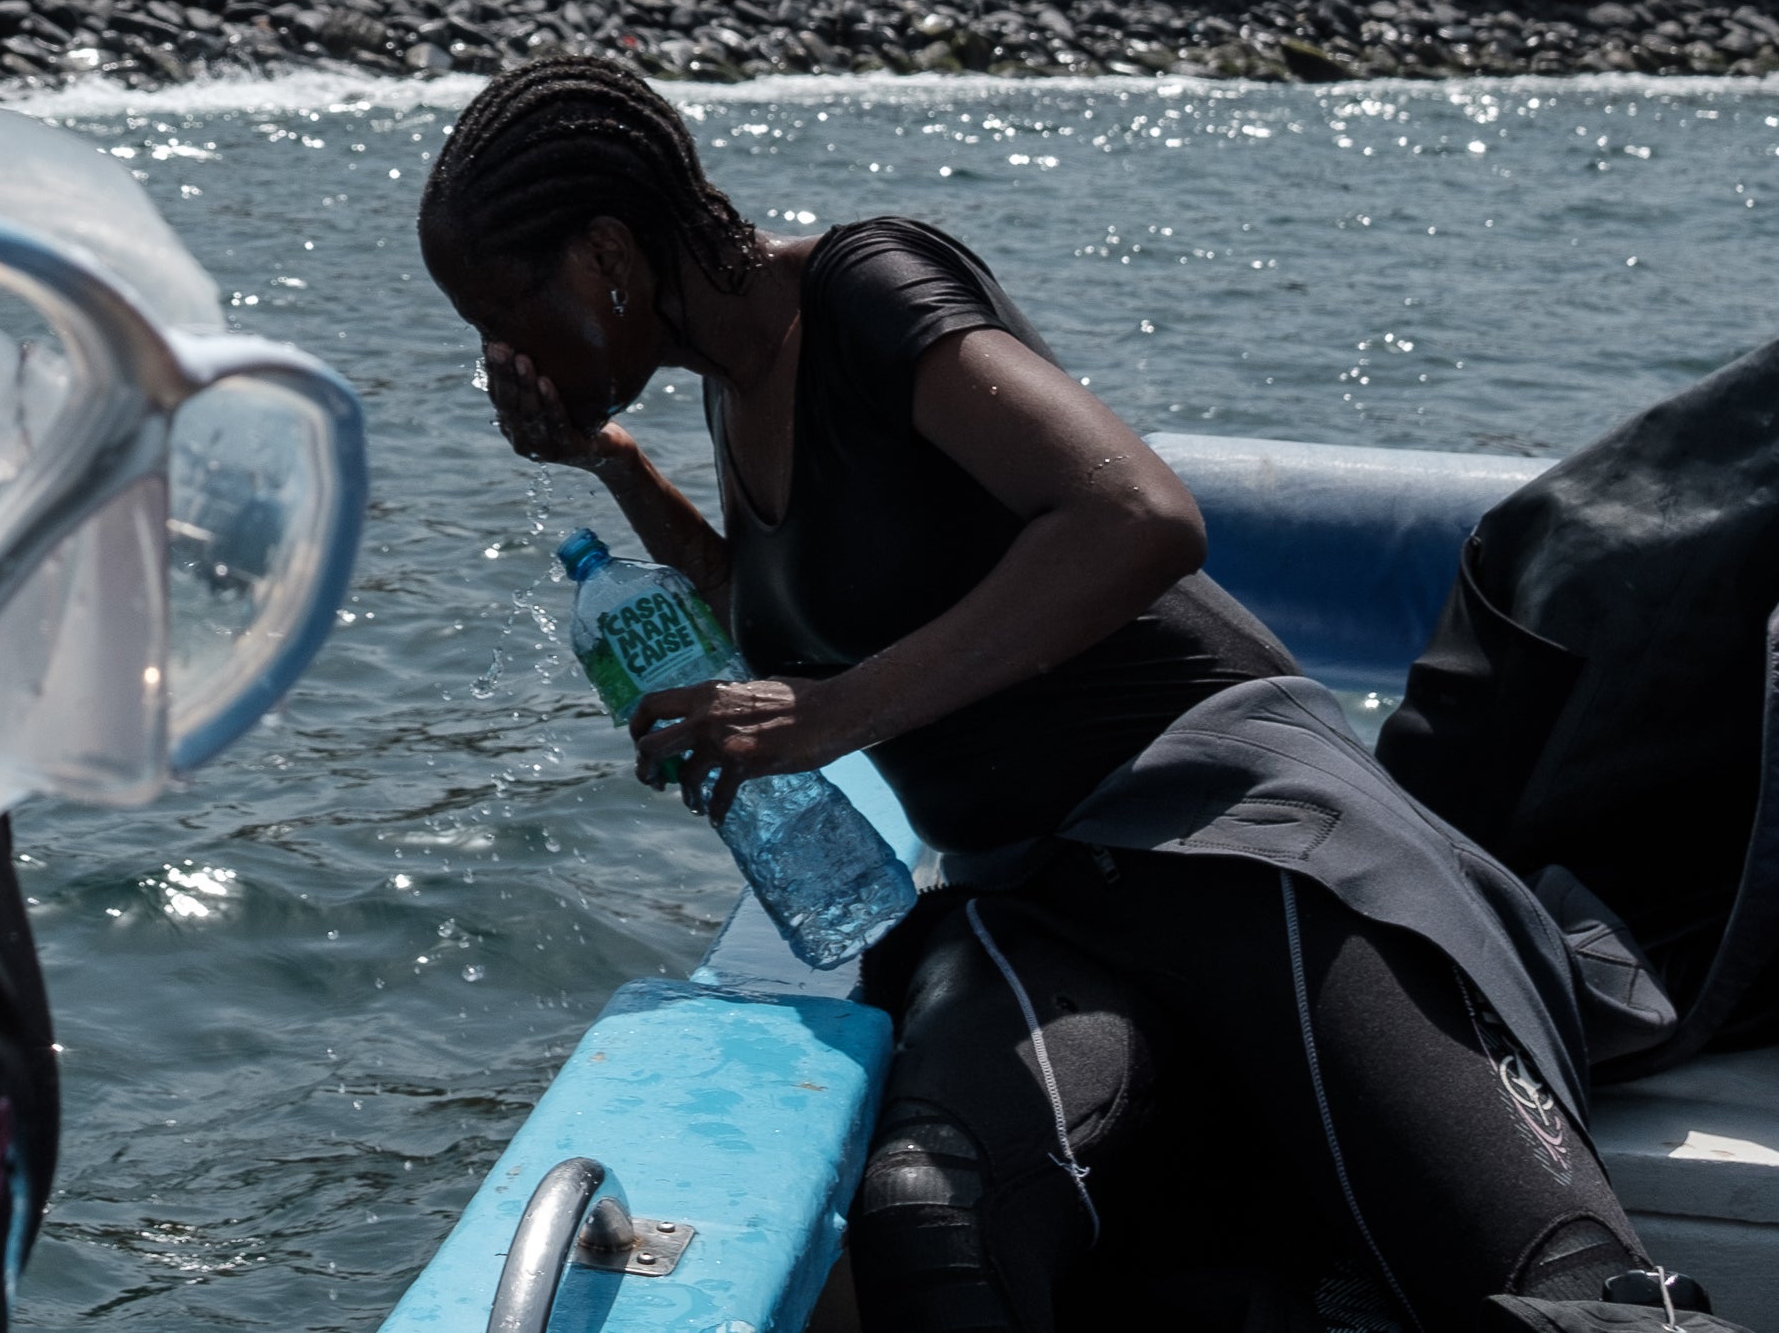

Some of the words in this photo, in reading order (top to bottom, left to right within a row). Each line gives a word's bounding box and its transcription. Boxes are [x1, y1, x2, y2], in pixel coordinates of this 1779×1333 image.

[606, 593, 672, 636] CASA
[618, 605, 681, 659] MAN
[627, 625, 695, 674] CAISE
